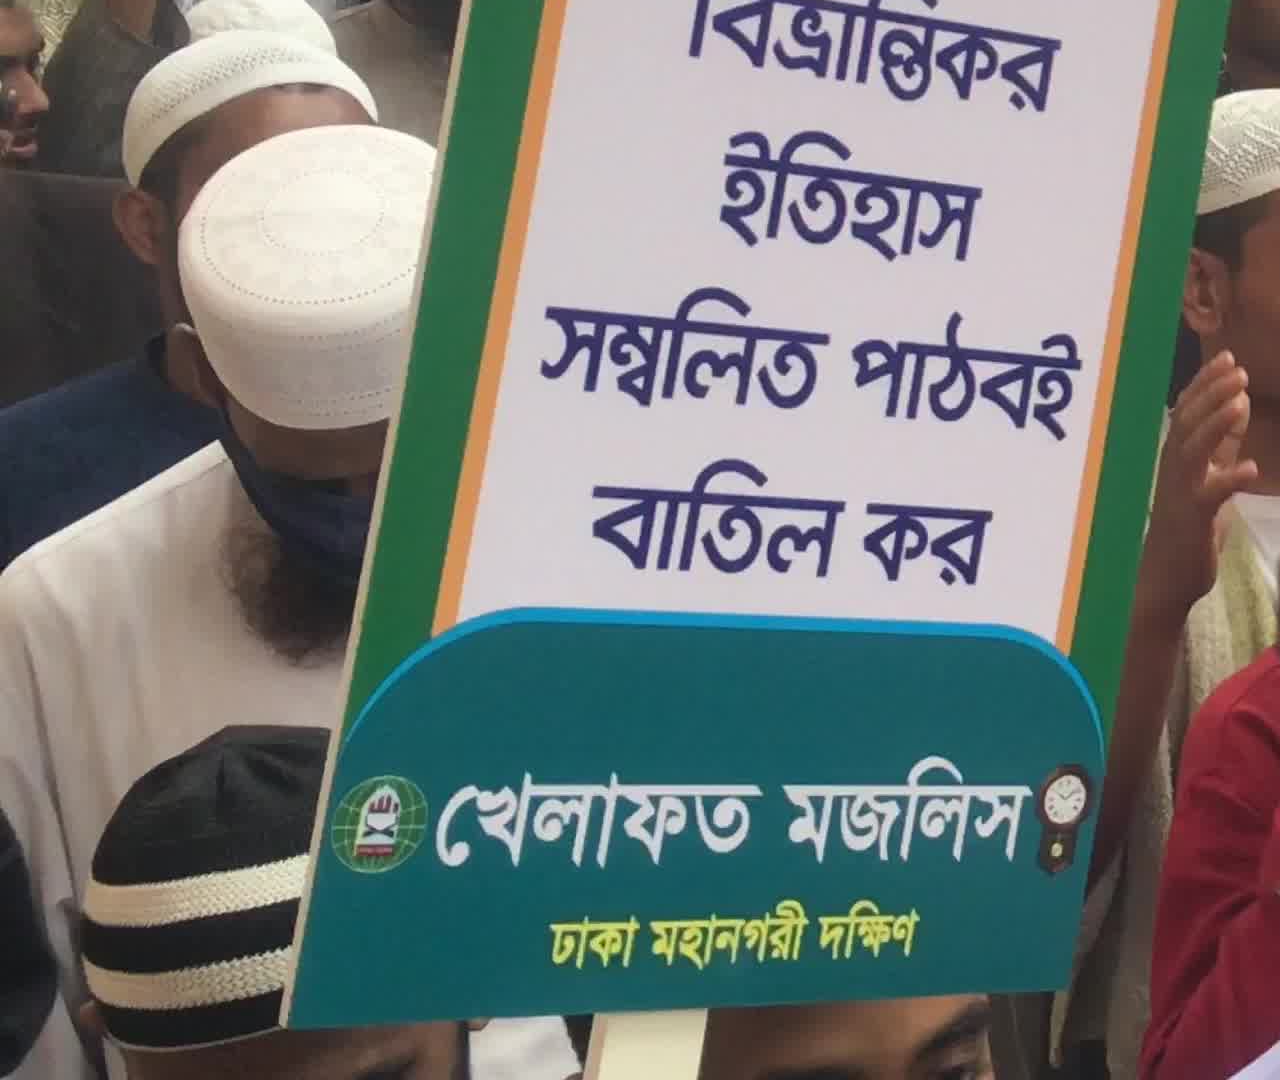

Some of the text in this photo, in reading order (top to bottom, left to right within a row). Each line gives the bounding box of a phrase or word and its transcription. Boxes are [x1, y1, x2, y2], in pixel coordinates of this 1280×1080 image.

[719, 130, 984, 262] ইতিহাস
[540, 287, 1083, 441] সম্বলিত পাঠবই
[592, 458, 994, 586] বাতিল কর
[434, 754, 1034, 869] খেলাফত মজলিস
[550, 898, 922, 971] ঢাকা মহানগরী দক্ষিণ
